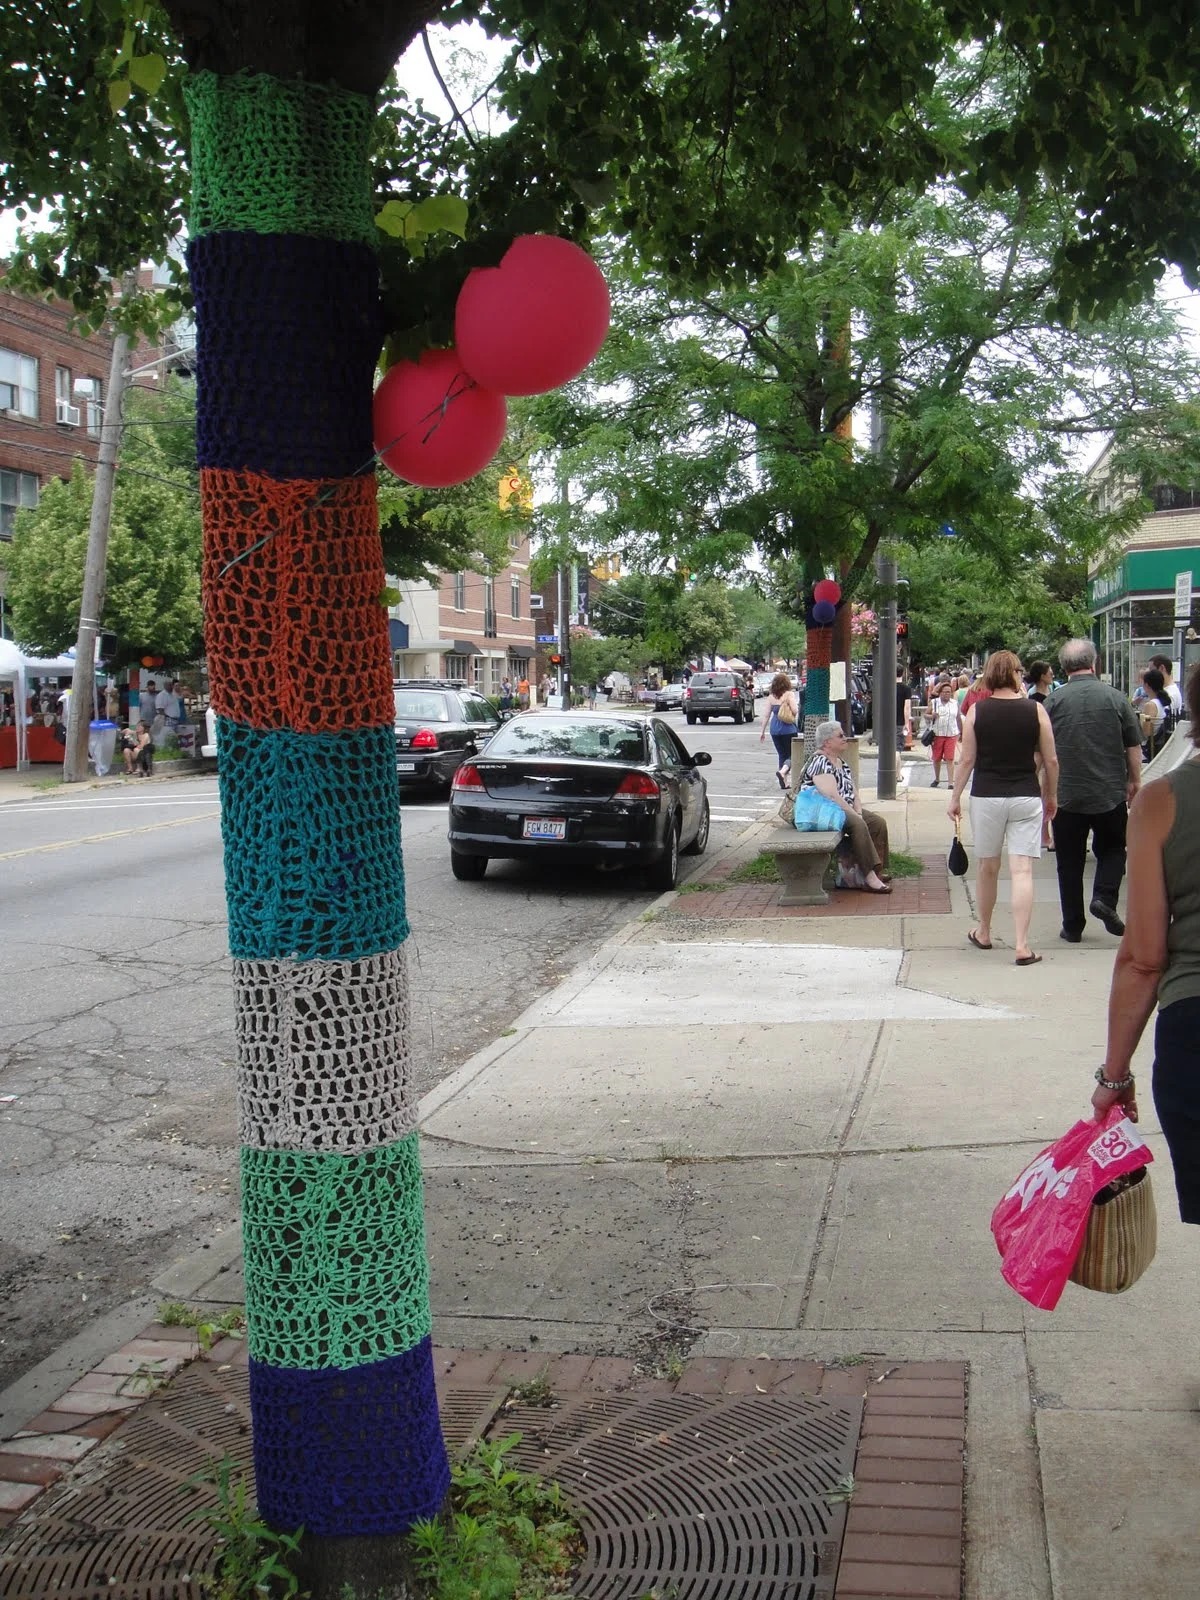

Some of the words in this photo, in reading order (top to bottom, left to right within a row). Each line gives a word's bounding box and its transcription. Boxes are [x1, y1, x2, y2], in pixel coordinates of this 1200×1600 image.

[526, 821, 541, 833] EGW
[543, 822, 562, 834] 8477
[1101, 1130, 1128, 1159] 30
